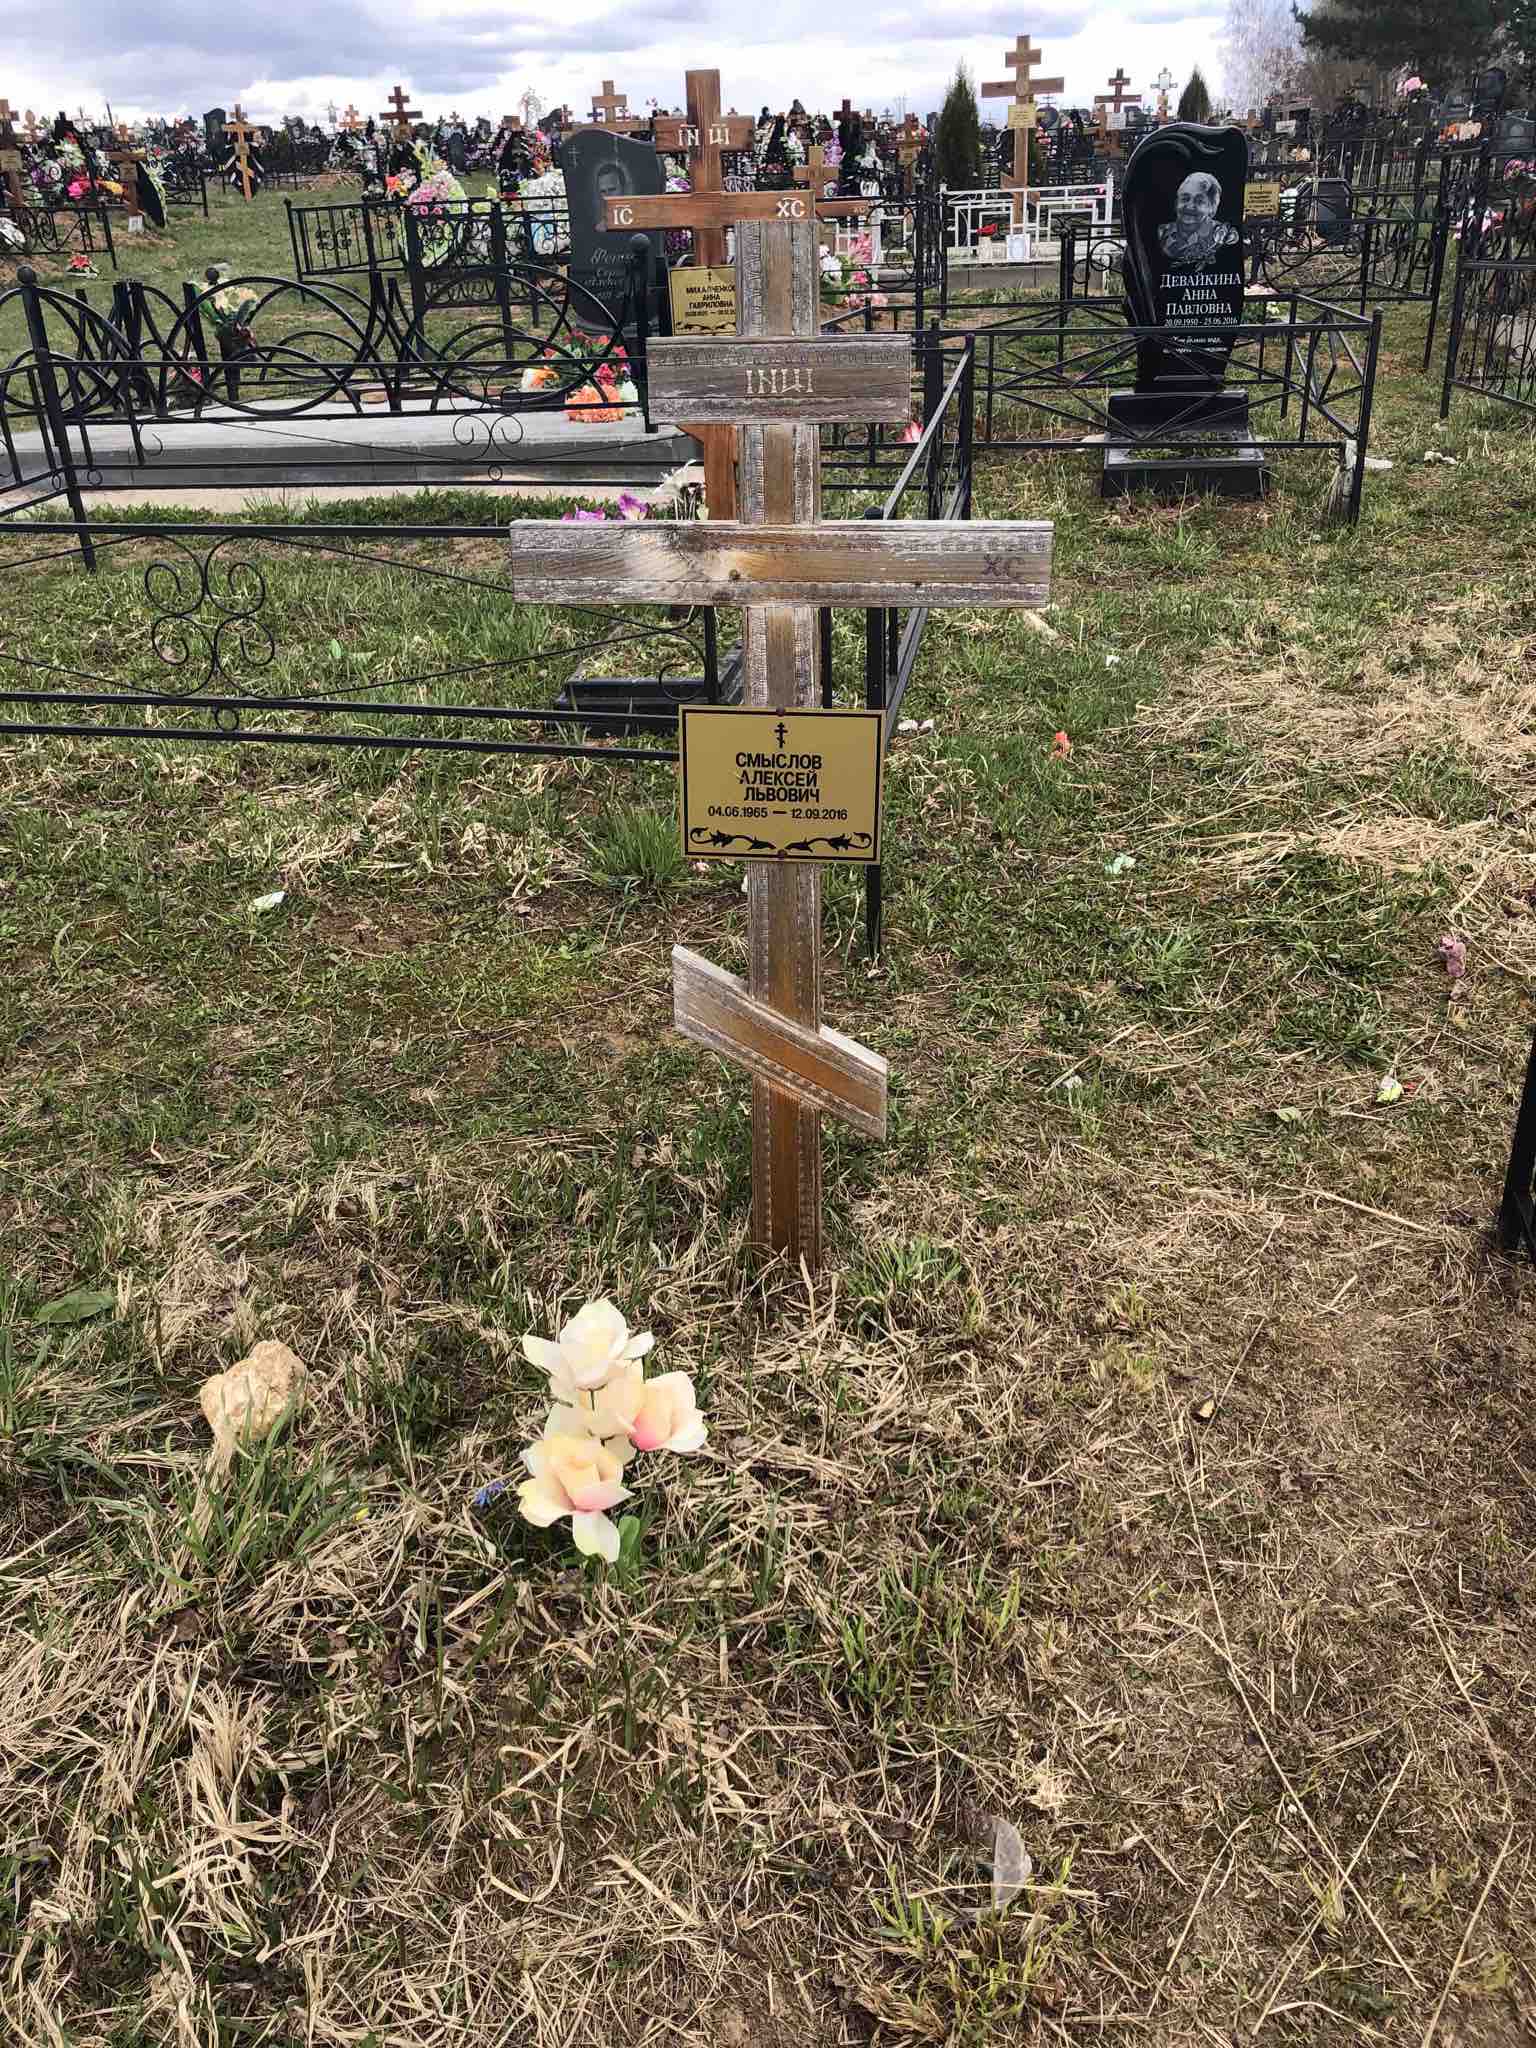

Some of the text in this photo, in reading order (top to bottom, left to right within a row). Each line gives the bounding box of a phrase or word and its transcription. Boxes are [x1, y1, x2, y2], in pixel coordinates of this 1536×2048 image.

[1160, 272, 1241, 289] ДЕВАЙКИНА
[1166, 303, 1232, 316] ПАВЛОВНА
[735, 752, 822, 770] СМЫСЛОВ
[739, 769, 818, 788] АЛЕКСЕЙ
[743, 788, 820, 803] ЛЬВОВИЧ
[708, 805, 767, 818] 04.06.1965
[792, 808, 847, 820] 12.09.2016
